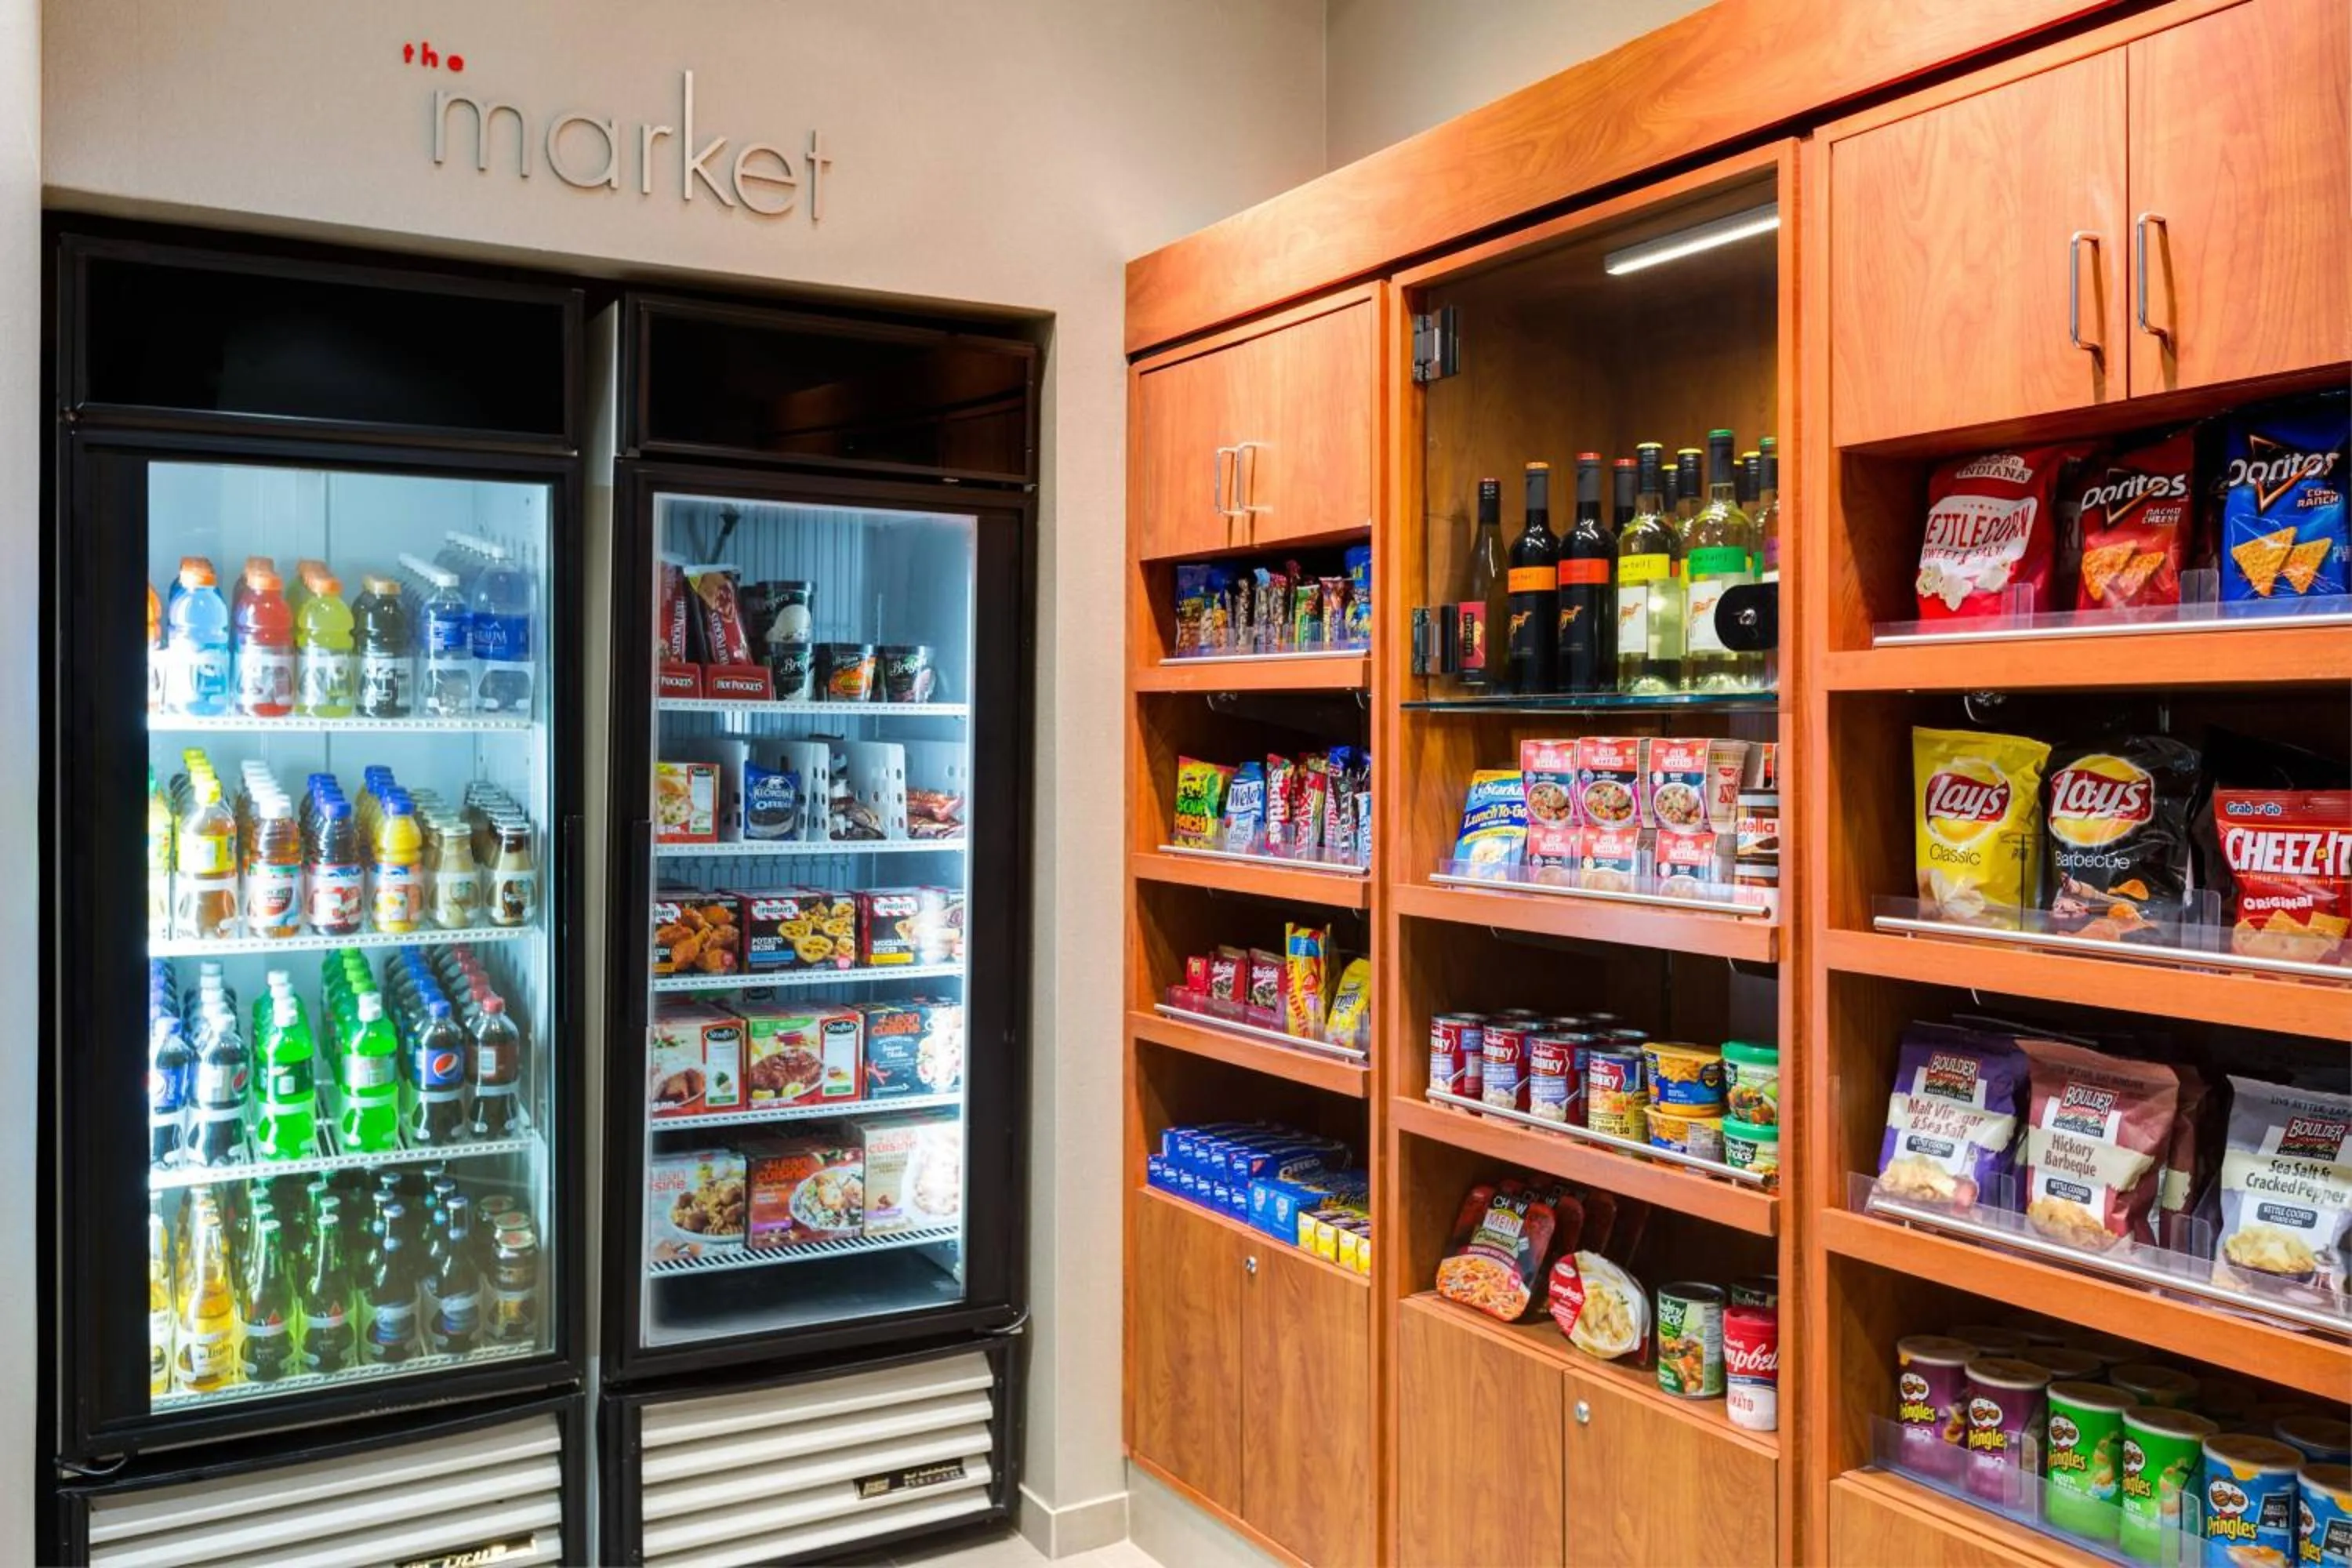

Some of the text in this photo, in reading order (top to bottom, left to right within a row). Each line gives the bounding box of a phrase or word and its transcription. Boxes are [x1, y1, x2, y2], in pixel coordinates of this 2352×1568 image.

[402, 42, 464, 72] the
[432, 69, 832, 220] market
[2228, 451, 2341, 488] Doritos
[2081, 474, 2187, 511] Doritos
[2296, 495, 2339, 509] RANCH
[2227, 800, 2252, 815] Grab
[2264, 803, 2282, 815] Go
[1929, 844, 1982, 866] Classic
[2055, 851, 2131, 870] Barbecue
[1907, 1098, 1933, 1116] Malt
[1921, 1117, 1943, 1134] Sea
[2288, 1120, 2347, 1142] BOULDER
[2052, 1134, 2096, 1162] Hickory
[2045, 1150, 2097, 1178] Barbeque
[2269, 1160, 2291, 1175] Sea
[2292, 1162, 2319, 1180] Salt
[2245, 1172, 2348, 1208] Cracked Pepper
[2207, 1515, 2258, 1543] Pringles
